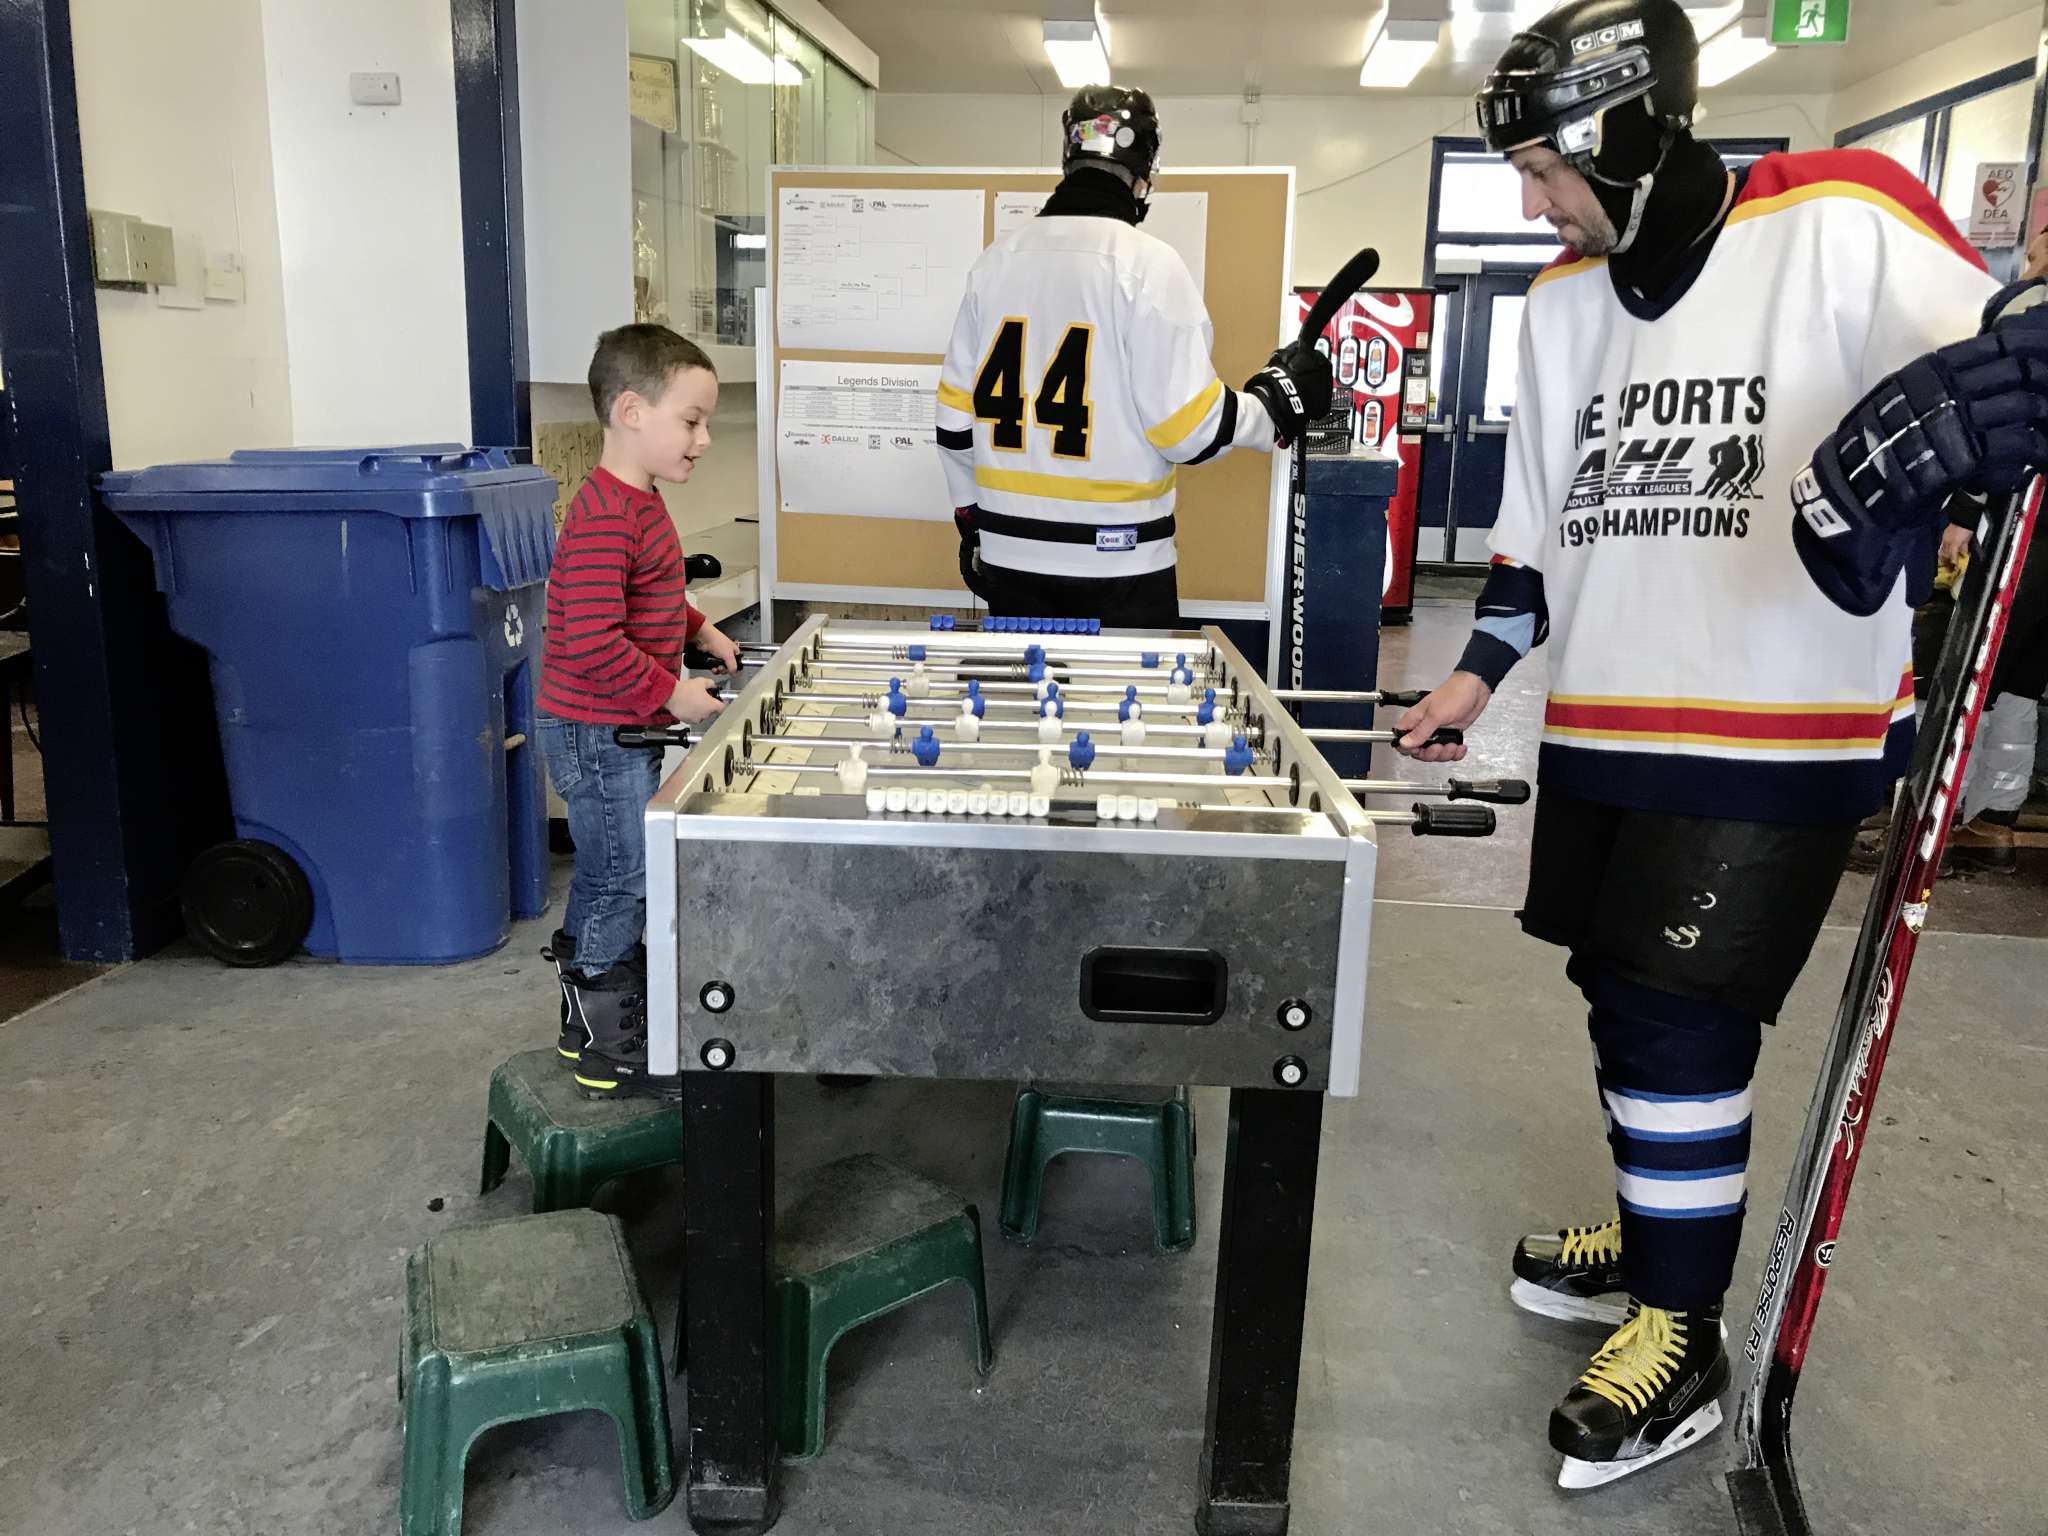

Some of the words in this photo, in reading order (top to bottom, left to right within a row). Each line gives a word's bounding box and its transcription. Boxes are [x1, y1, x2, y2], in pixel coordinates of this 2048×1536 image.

[1573, 20, 1643, 54] CCM
[1988, 169, 2014, 180] AED
[1983, 208, 2009, 219] DEA
[1411, 357, 1426, 367] Thank
[837, 375, 879, 386] Legends
[881, 376, 919, 388] Division
[972, 316, 1094, 461] 44
[895, 436, 913, 446] PAL
[1566, 495, 1599, 508] ADULT
[1608, 485, 1642, 496] CKEY
[1644, 484, 1690, 494] LEAGUES
[1559, 516, 1600, 548] 199
[1600, 507, 1750, 538] HAMPIONS
[1291, 492, 1306, 693] SHER-WOOD
[1755, 1206, 1796, 1327] RESPONSE
[1744, 1323, 1762, 1364] R1
